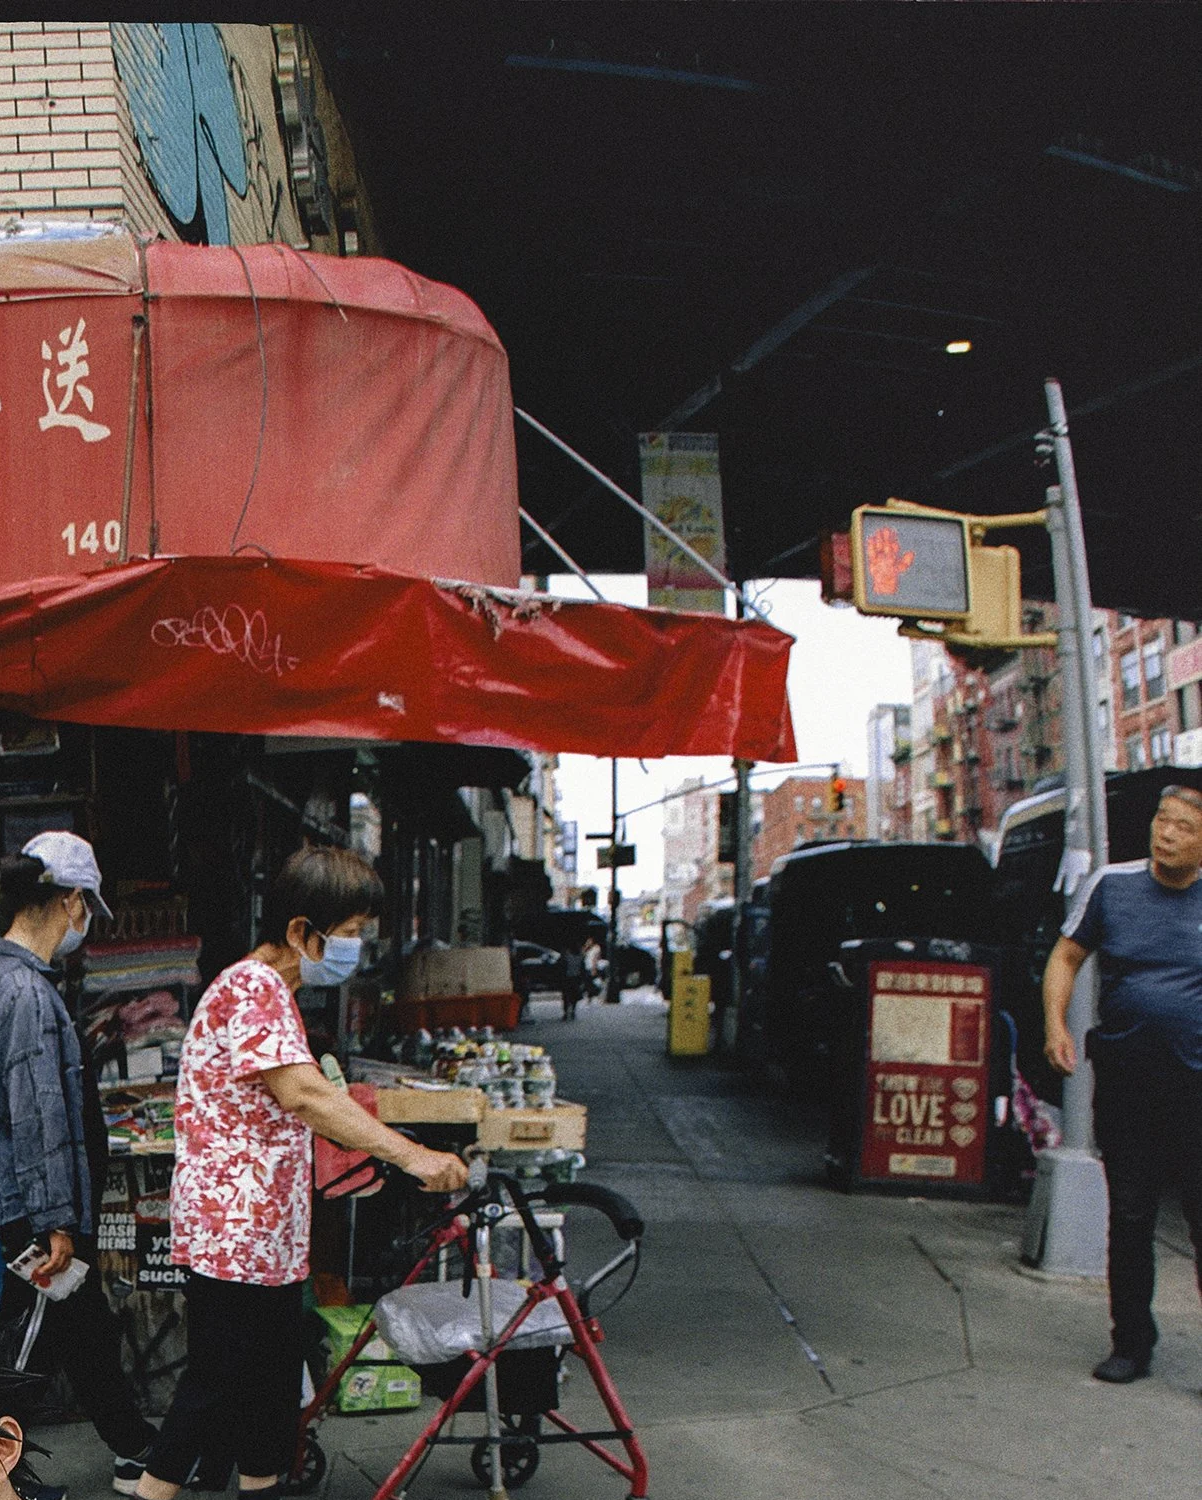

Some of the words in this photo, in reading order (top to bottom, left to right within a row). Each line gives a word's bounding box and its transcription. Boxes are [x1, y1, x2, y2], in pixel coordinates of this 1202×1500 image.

[60, 519, 122, 556] 140
[873, 1092, 947, 1128] LOVE
[99, 1212, 136, 1224] YAMS
[145, 1253, 173, 1266] wo
[138, 1268, 191, 1284] suck
